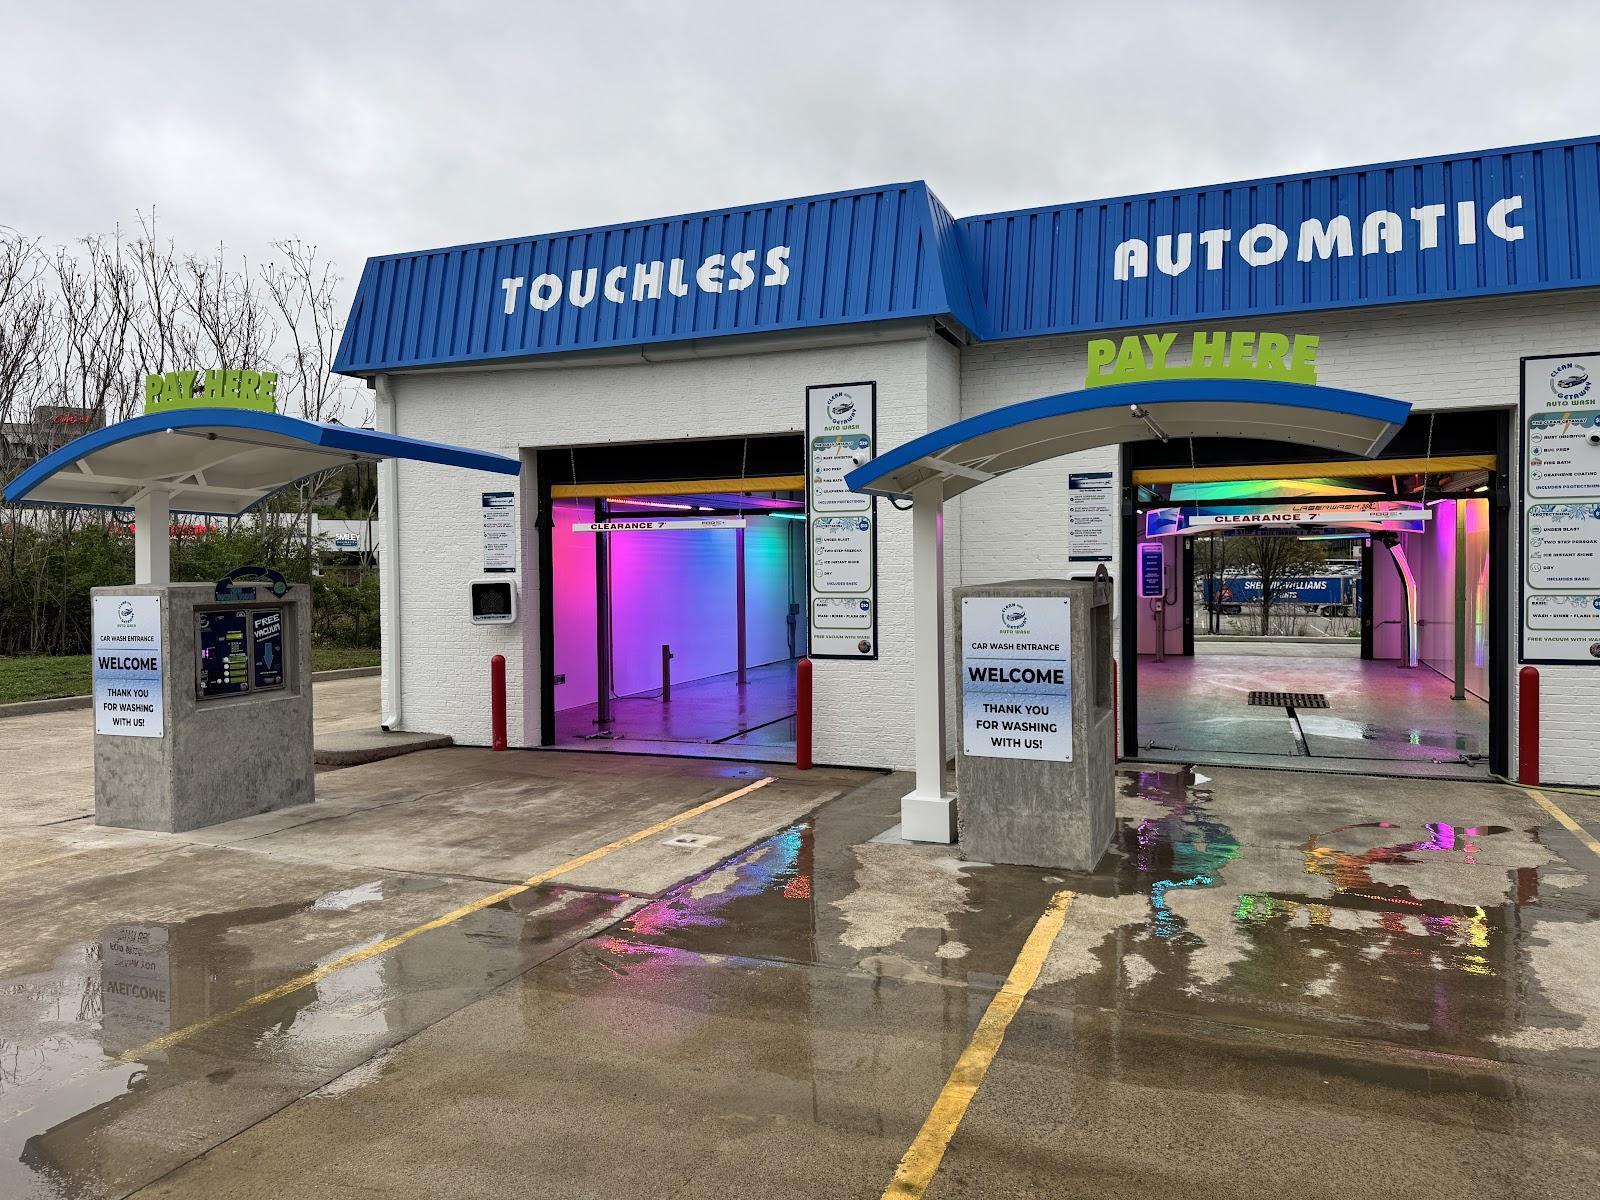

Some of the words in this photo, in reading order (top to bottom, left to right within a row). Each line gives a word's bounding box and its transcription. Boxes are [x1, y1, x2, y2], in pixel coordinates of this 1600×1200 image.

[1114, 196, 1524, 281] AUTOMATIC
[502, 246, 790, 314] TOUCHLESS
[1088, 332, 1178, 376] PAY
[1191, 331, 1320, 374] HERE
[1550, 363, 1573, 377] CLEAN
[145, 370, 199, 403] PAY
[205, 369, 278, 401] HERE
[1557, 381, 1592, 400] GETAWAY
[1214, 514, 1301, 522] CLEARANCE
[591, 522, 653, 530] CLEARANCE
[335, 533, 360, 541] SMILEY
[254, 613, 280, 629] FREE
[254, 623, 280, 638] VACUUM
[972, 642, 988, 650] CAR
[98, 656, 158, 671] WELCOME
[968, 667, 1064, 685] WELCOME
[108, 688, 132, 697] THANK
[133, 689, 149, 698] YOU
[103, 702, 117, 711] FOR
[119, 703, 154, 713] WASHING
[983, 703, 1022, 714] THANK
[1025, 705, 1049, 715] YOU
[112, 718, 131, 727] WITH
[133, 718, 145, 727] US!
[976, 720, 998, 730] FOR
[1002, 721, 1057, 733] WASHING
[991, 737, 1021, 748] WITH
[1025, 739, 1043, 749] US!
